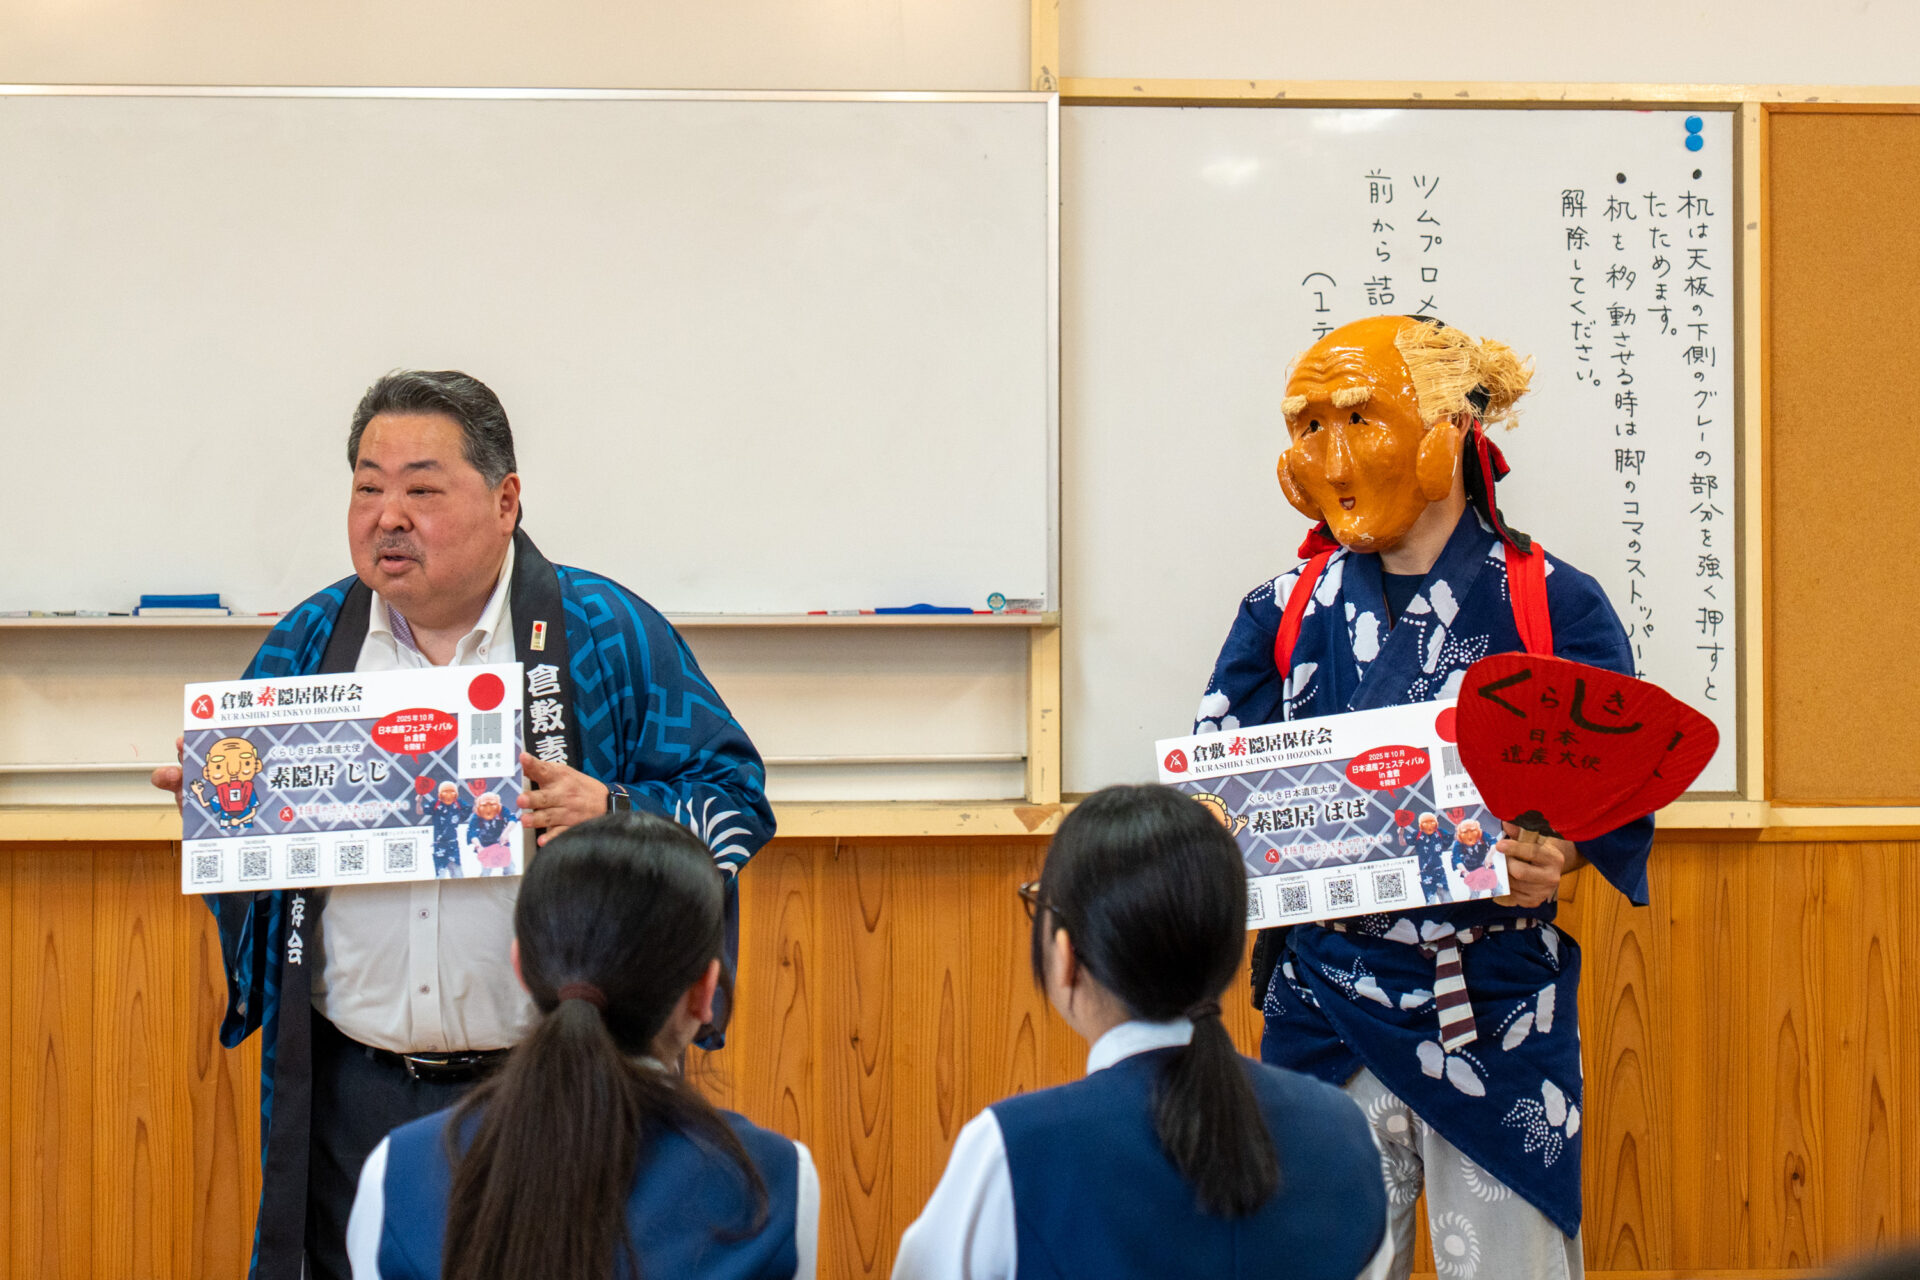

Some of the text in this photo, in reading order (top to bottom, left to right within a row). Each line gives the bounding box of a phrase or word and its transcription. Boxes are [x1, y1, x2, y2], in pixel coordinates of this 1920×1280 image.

[1642, 191, 1677, 336] たためます。
[1560, 189, 1601, 387] 解除してください。
[220, 704, 361, 721] KURASHIKI SUINKYO HOZONKAI
[1477, 668, 1644, 735] くらしき
[270, 743, 361, 758] くらしき日本遺産大使
[1530, 728, 1580, 746] 日本
[1195, 747, 1332, 773] KURASHIKI SUINKYO HOZONKAI
[1501, 743, 1601, 773] 遺産大使
[270, 761, 388, 789] 素隠居 じじ
[1248, 783, 1338, 804] くらしき日本遺産大使
[1252, 797, 1367, 834] 素隠居 ばば
